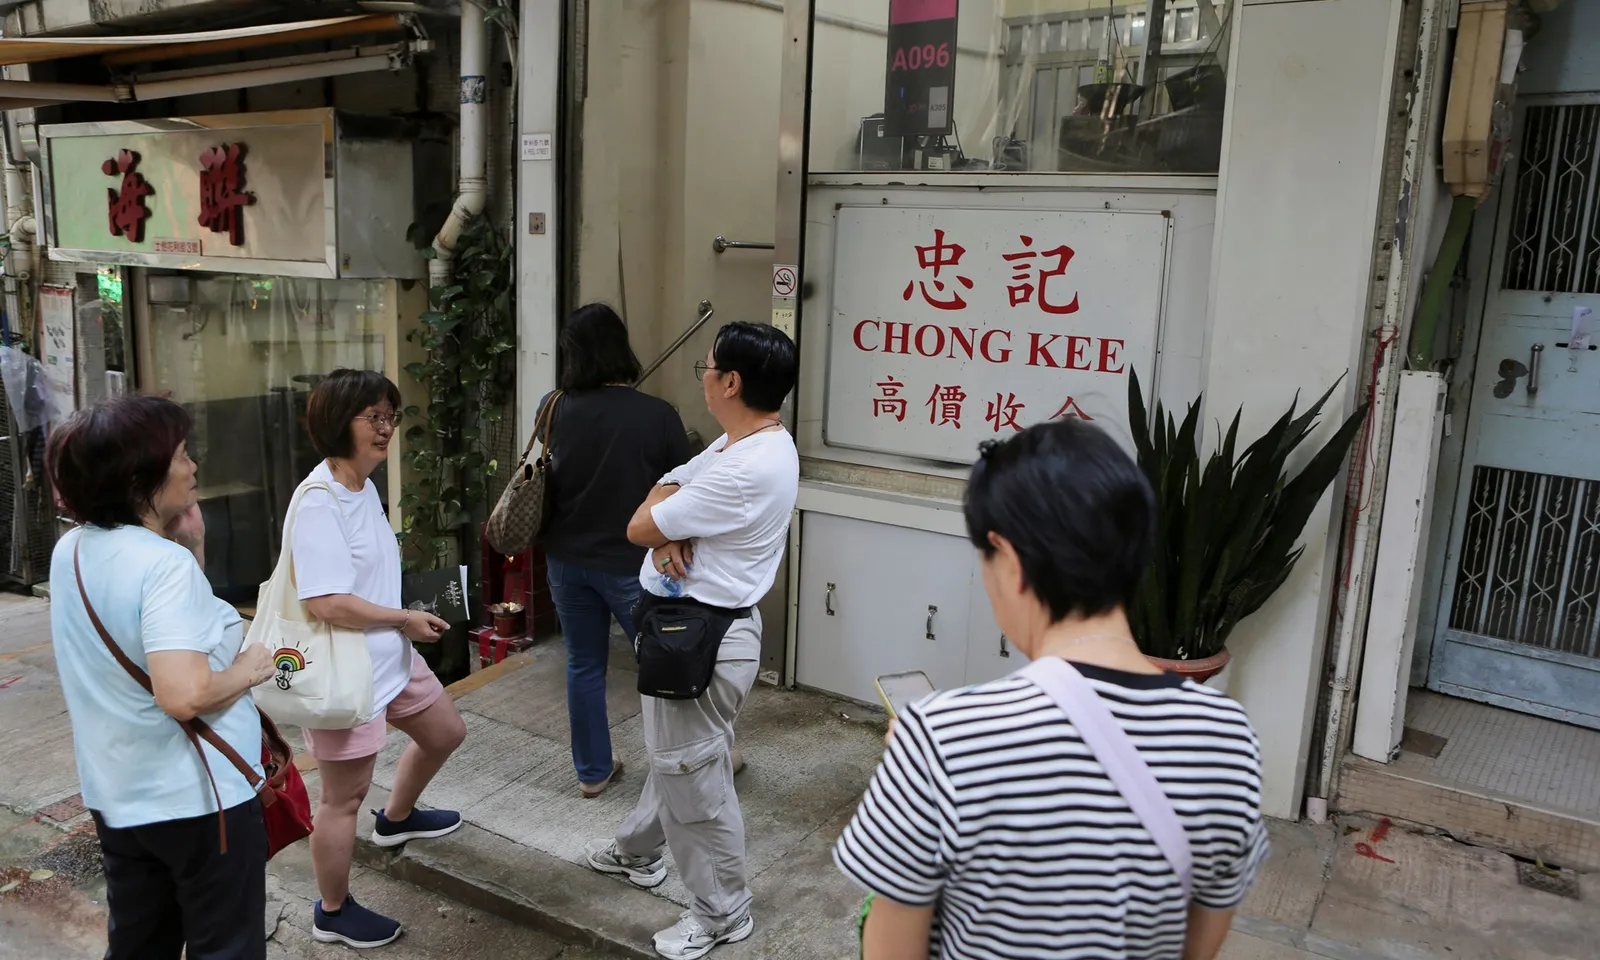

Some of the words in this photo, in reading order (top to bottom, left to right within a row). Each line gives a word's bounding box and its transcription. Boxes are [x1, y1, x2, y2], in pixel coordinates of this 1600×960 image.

[891, 42, 950, 71] A096
[930, 103, 947, 112] A305
[903, 229, 1080, 315] 忠記
[853, 320, 1013, 364] CHONG
[1025, 332, 1126, 375] KEE
